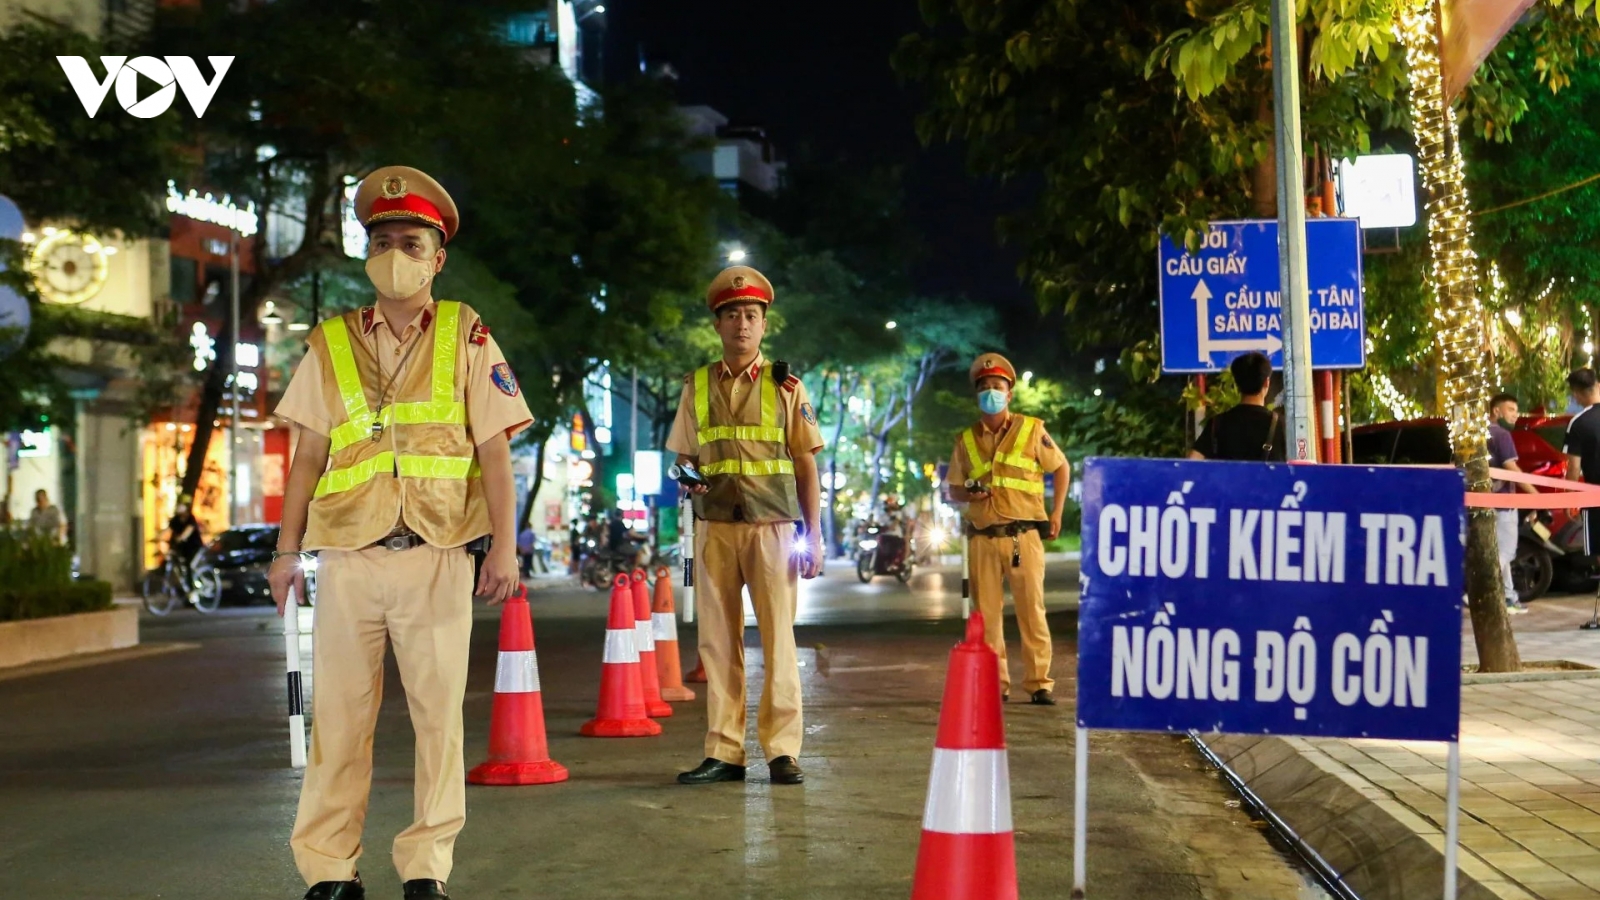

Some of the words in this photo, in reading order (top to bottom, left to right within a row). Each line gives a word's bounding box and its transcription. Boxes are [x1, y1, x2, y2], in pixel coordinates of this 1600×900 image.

[1185, 226, 1227, 249] ỞI
[1166, 252, 1203, 276] CẦU
[1206, 250, 1247, 275] GIẤY
[1225, 285, 1260, 309] CẦU
[1317, 285, 1354, 307] TÂN
[1214, 311, 1252, 332] SÂN
[1256, 314, 1282, 331] BA
[1309, 308, 1326, 334] ỘI
[1329, 308, 1358, 330] BÀI
[1098, 481, 1216, 579] CHỐT
[1228, 480, 1347, 584] KIỂM
[1360, 512, 1449, 587] TRA
[1111, 602, 1241, 702] NỒNG
[1254, 616, 1317, 720] ĐỘ
[1331, 609, 1429, 708] CỒN
